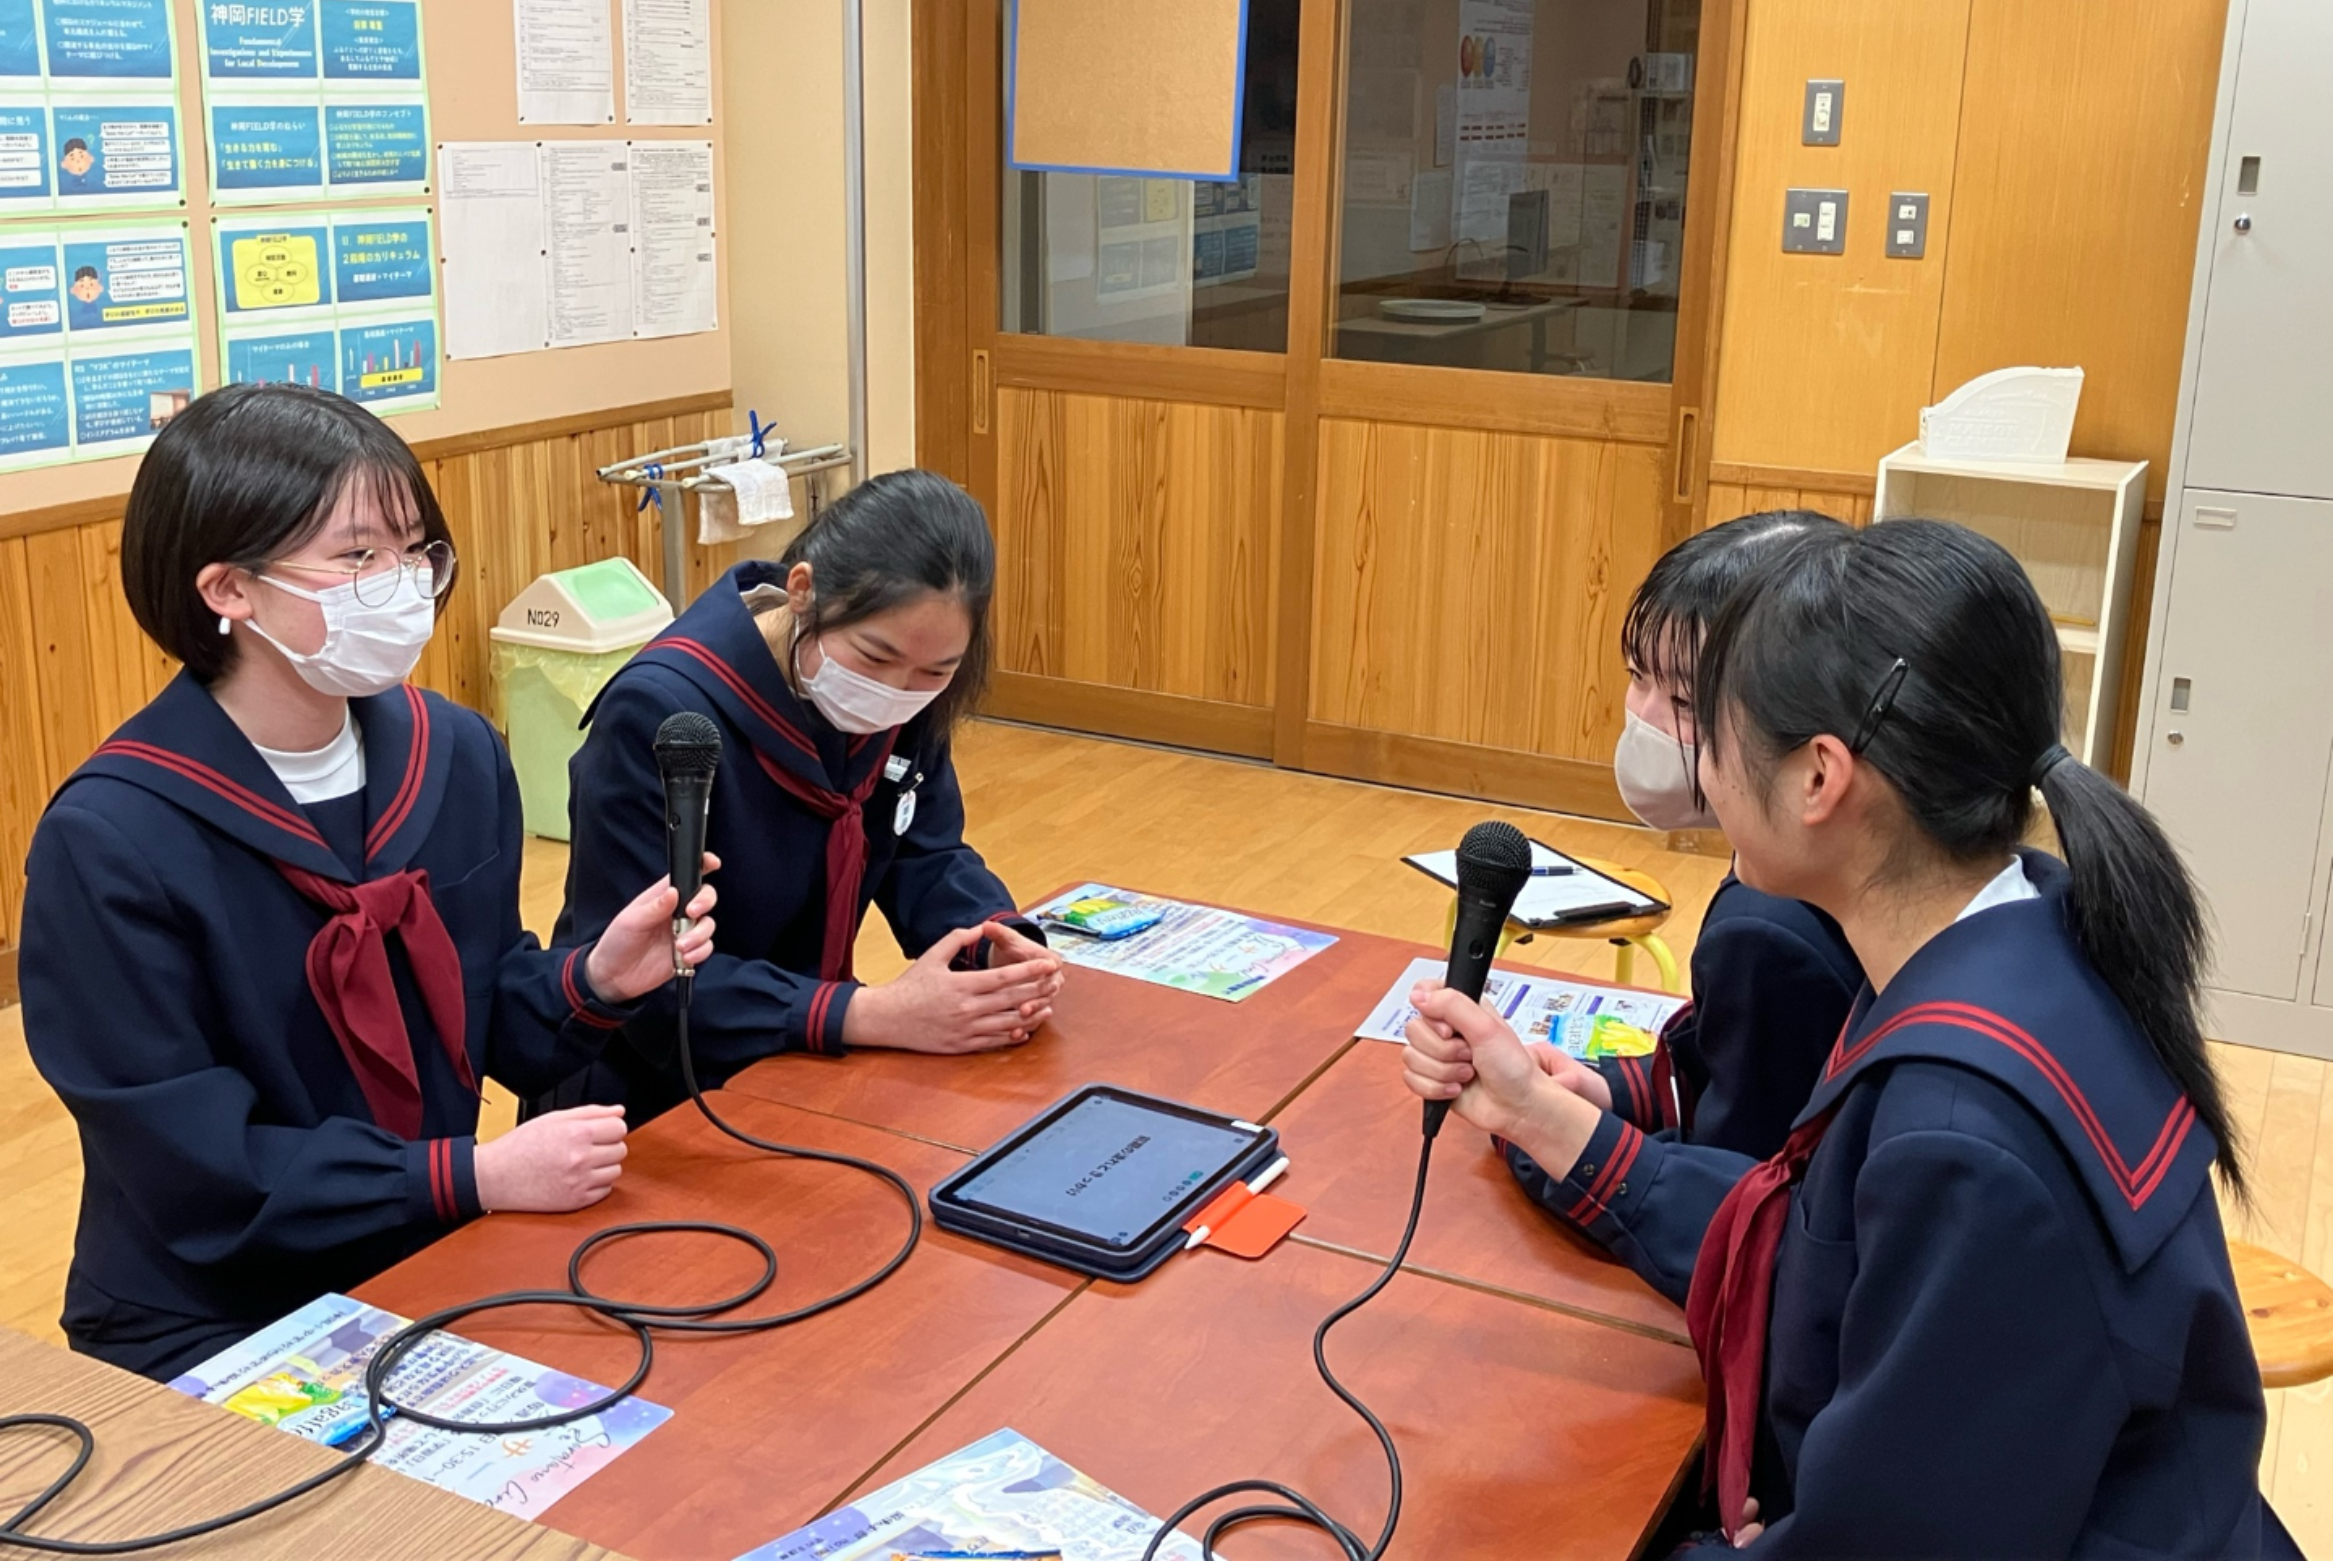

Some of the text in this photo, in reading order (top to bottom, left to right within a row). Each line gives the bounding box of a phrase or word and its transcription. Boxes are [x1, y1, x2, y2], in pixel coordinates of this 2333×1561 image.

[210, 3, 305, 28] 神岡FIELD学
[224, 59, 236, 68] for
[237, 59, 255, 68] Local
